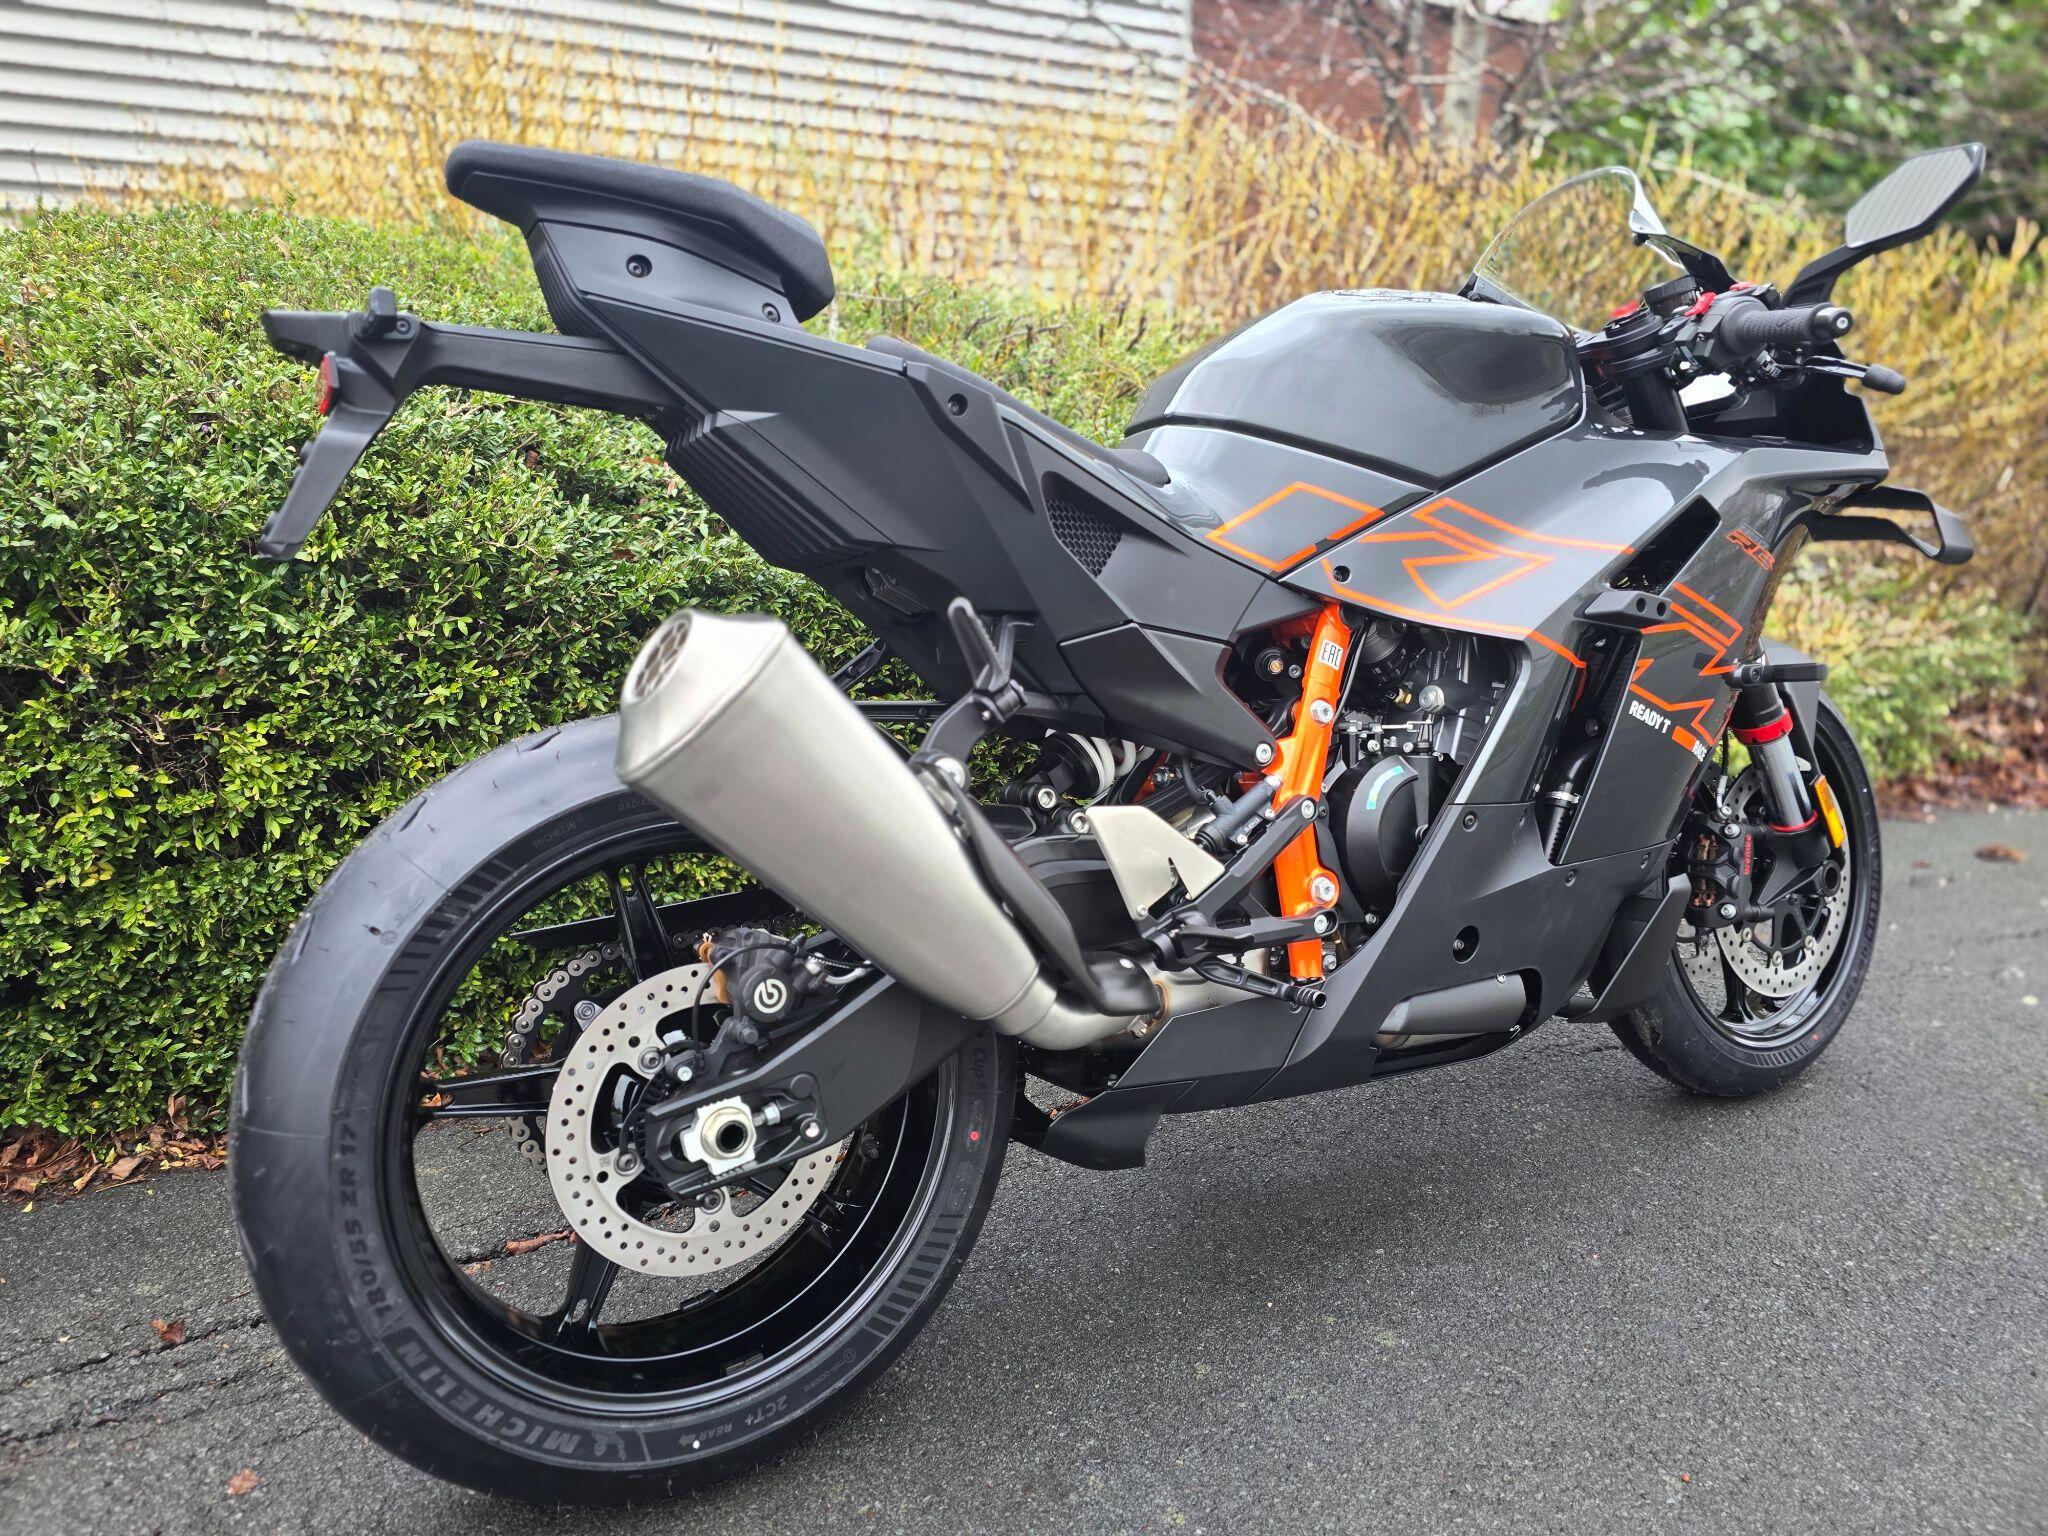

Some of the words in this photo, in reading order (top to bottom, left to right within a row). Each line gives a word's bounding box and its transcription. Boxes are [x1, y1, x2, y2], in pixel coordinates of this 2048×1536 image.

[1628, 700, 1664, 730] READY
[339, 1122, 358, 1157] 17
[338, 1166, 359, 1207] ZR
[343, 1218, 394, 1320] 180/55
[399, 1343, 582, 1455] MICHELIN
